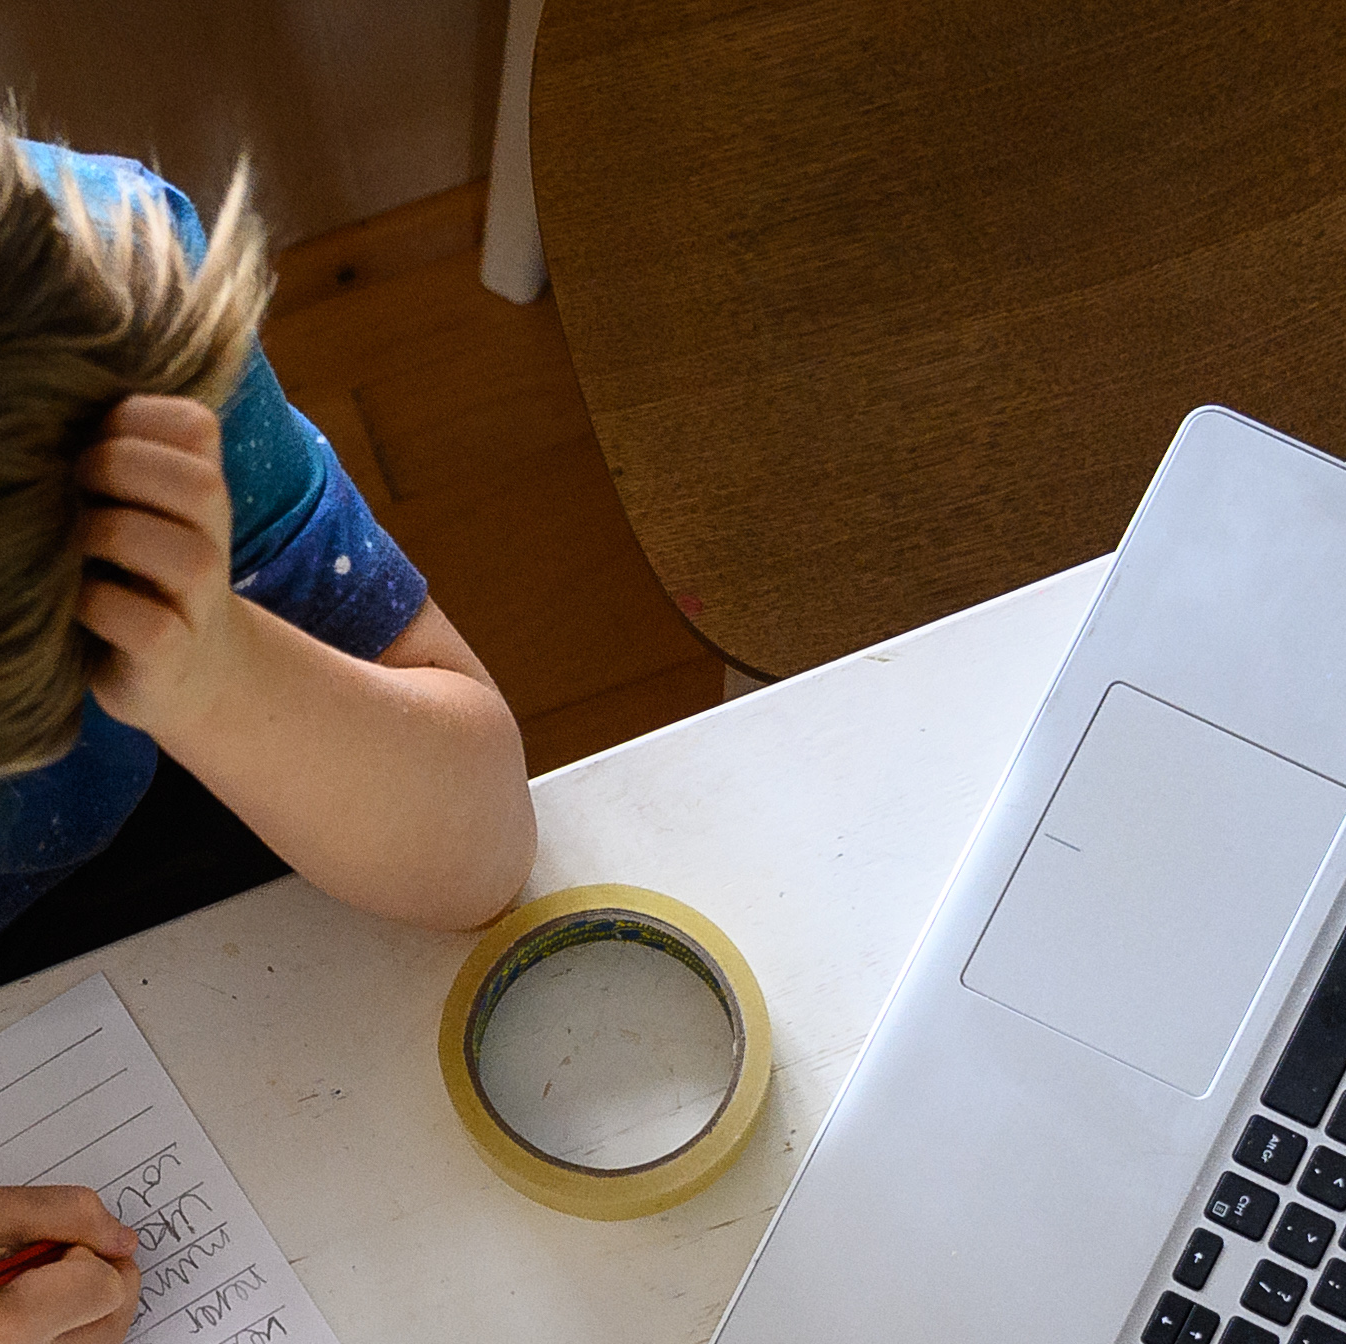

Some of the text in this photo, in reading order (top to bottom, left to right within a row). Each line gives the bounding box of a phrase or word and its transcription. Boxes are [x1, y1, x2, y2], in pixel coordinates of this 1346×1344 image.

[1260, 1133, 1279, 1163] Alt Gr
[1233, 1194, 1250, 1216] Ctrl
[183, 1268, 267, 1334] never
